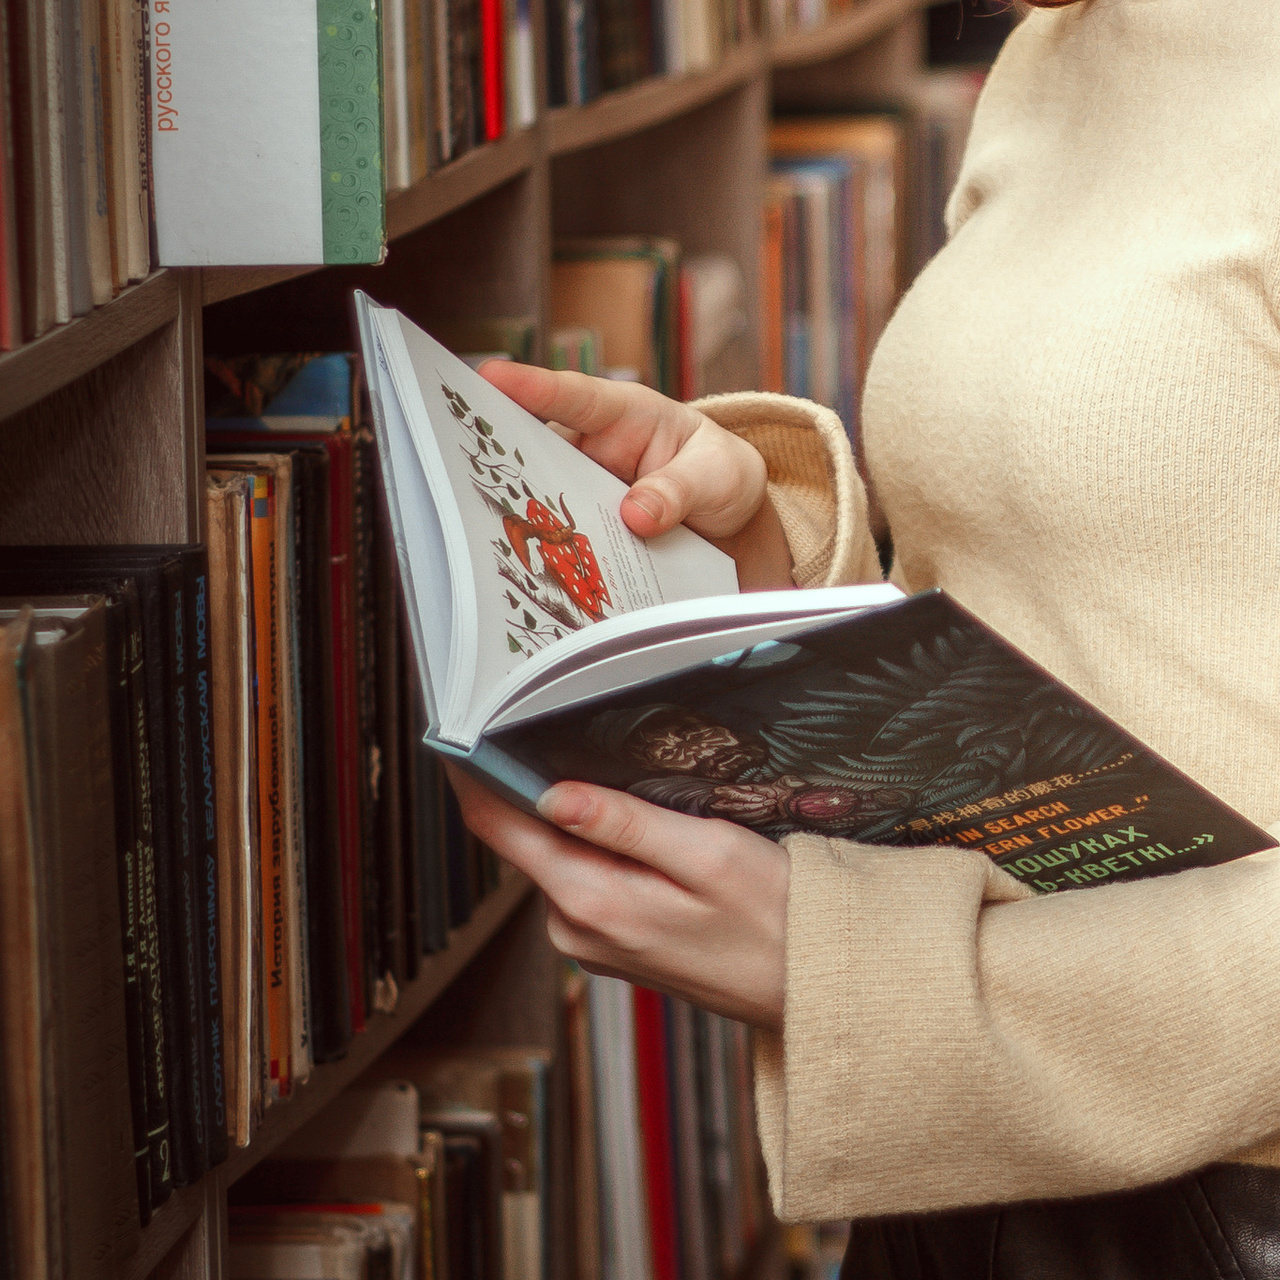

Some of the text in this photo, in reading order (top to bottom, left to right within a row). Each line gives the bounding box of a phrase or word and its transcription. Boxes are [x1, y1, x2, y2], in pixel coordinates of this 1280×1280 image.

[153, 22, 179, 132] русского
[268, 541, 283, 988] История зарубежной литературы
[984, 801, 1071, 835] SEARCH
[174, 590, 203, 1145] СЛОЎНІК ПАРОНІМАЎ БЕЛАРУСКАЙ МОВЫ
[196, 575, 224, 1127] СЛОЎНІК ПАРОНІМАЎ БЕЛАРУСКАЙ МОВЫ
[973, 833, 1035, 856] ERN
[160, 1138, 170, 1182] 2
